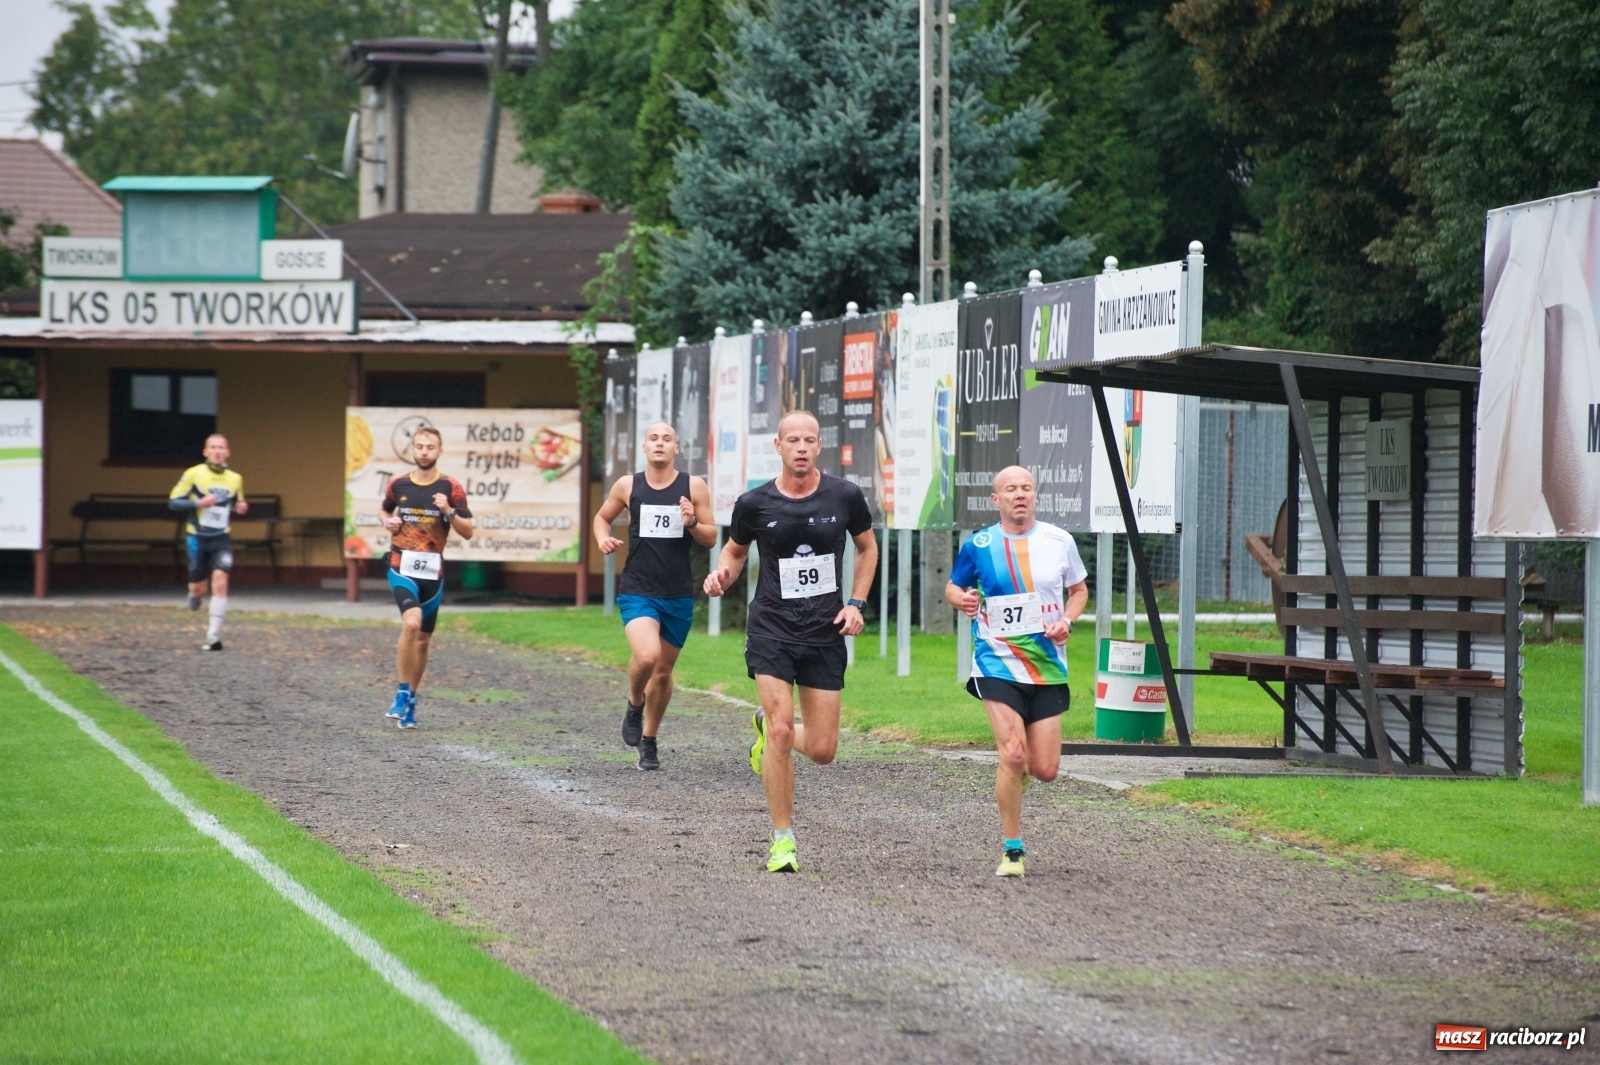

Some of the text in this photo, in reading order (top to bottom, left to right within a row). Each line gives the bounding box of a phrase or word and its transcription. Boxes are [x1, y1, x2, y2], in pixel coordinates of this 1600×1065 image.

[48, 245, 118, 265] TWORKÓW
[275, 248, 326, 268] GOŚCIE
[50, 285, 344, 324] LKS 05 TWORKÓW
[1098, 285, 1176, 335] GMINA KRZYŻANOWICE
[1029, 302, 1070, 364] GRAN
[466, 423, 524, 442] Kebab
[1380, 427, 1395, 456] LKS
[466, 451, 521, 473] Frytki
[466, 478, 510, 500] Lody
[654, 514, 670, 528] 78
[413, 560, 427, 571] 87
[798, 568, 819, 586] 59
[1003, 606, 1023, 624] 37
